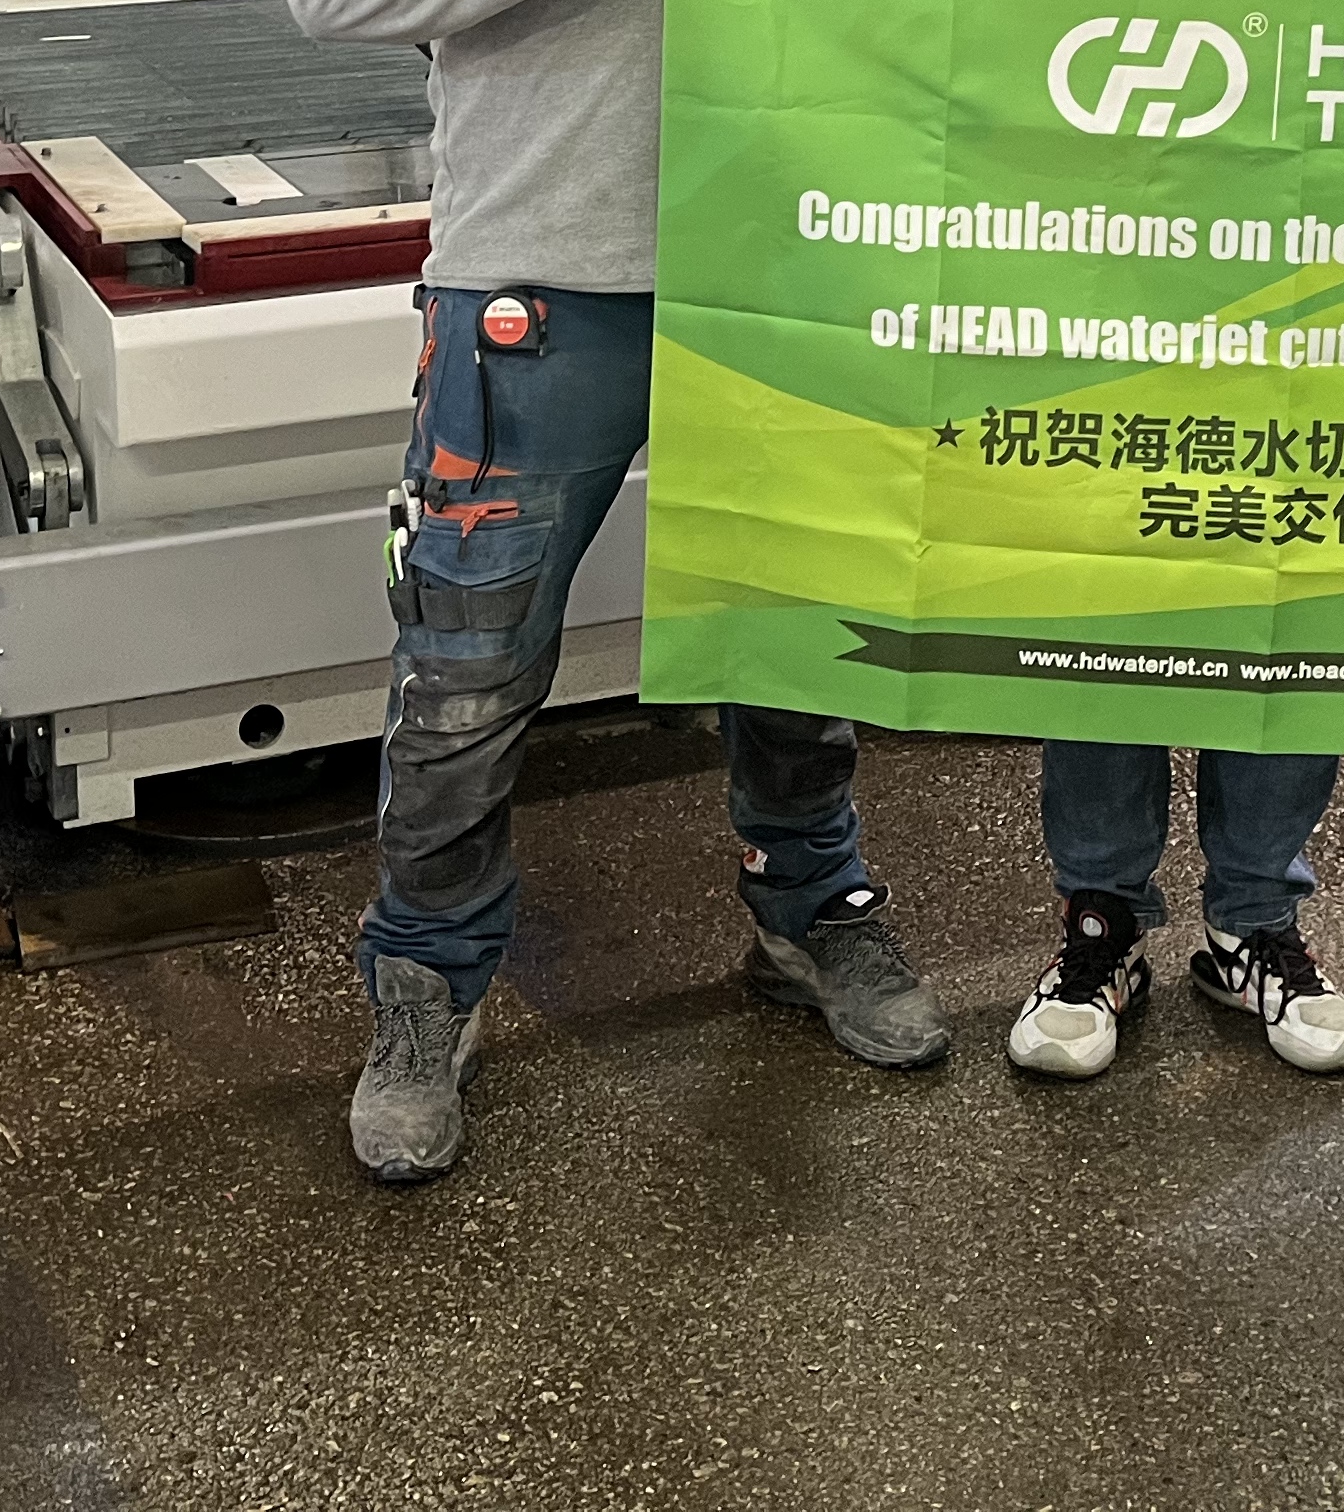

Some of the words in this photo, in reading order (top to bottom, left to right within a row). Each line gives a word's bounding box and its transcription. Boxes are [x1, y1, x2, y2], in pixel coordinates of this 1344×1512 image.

[797, 190, 1198, 259] Congratulations
[1209, 218, 1272, 262] on
[870, 303, 920, 350] of
[928, 304, 1048, 358] HEAD
[1058, 314, 1269, 370] waterjet
[1018, 649, 1229, 678] www.hdwaterjet.cn
